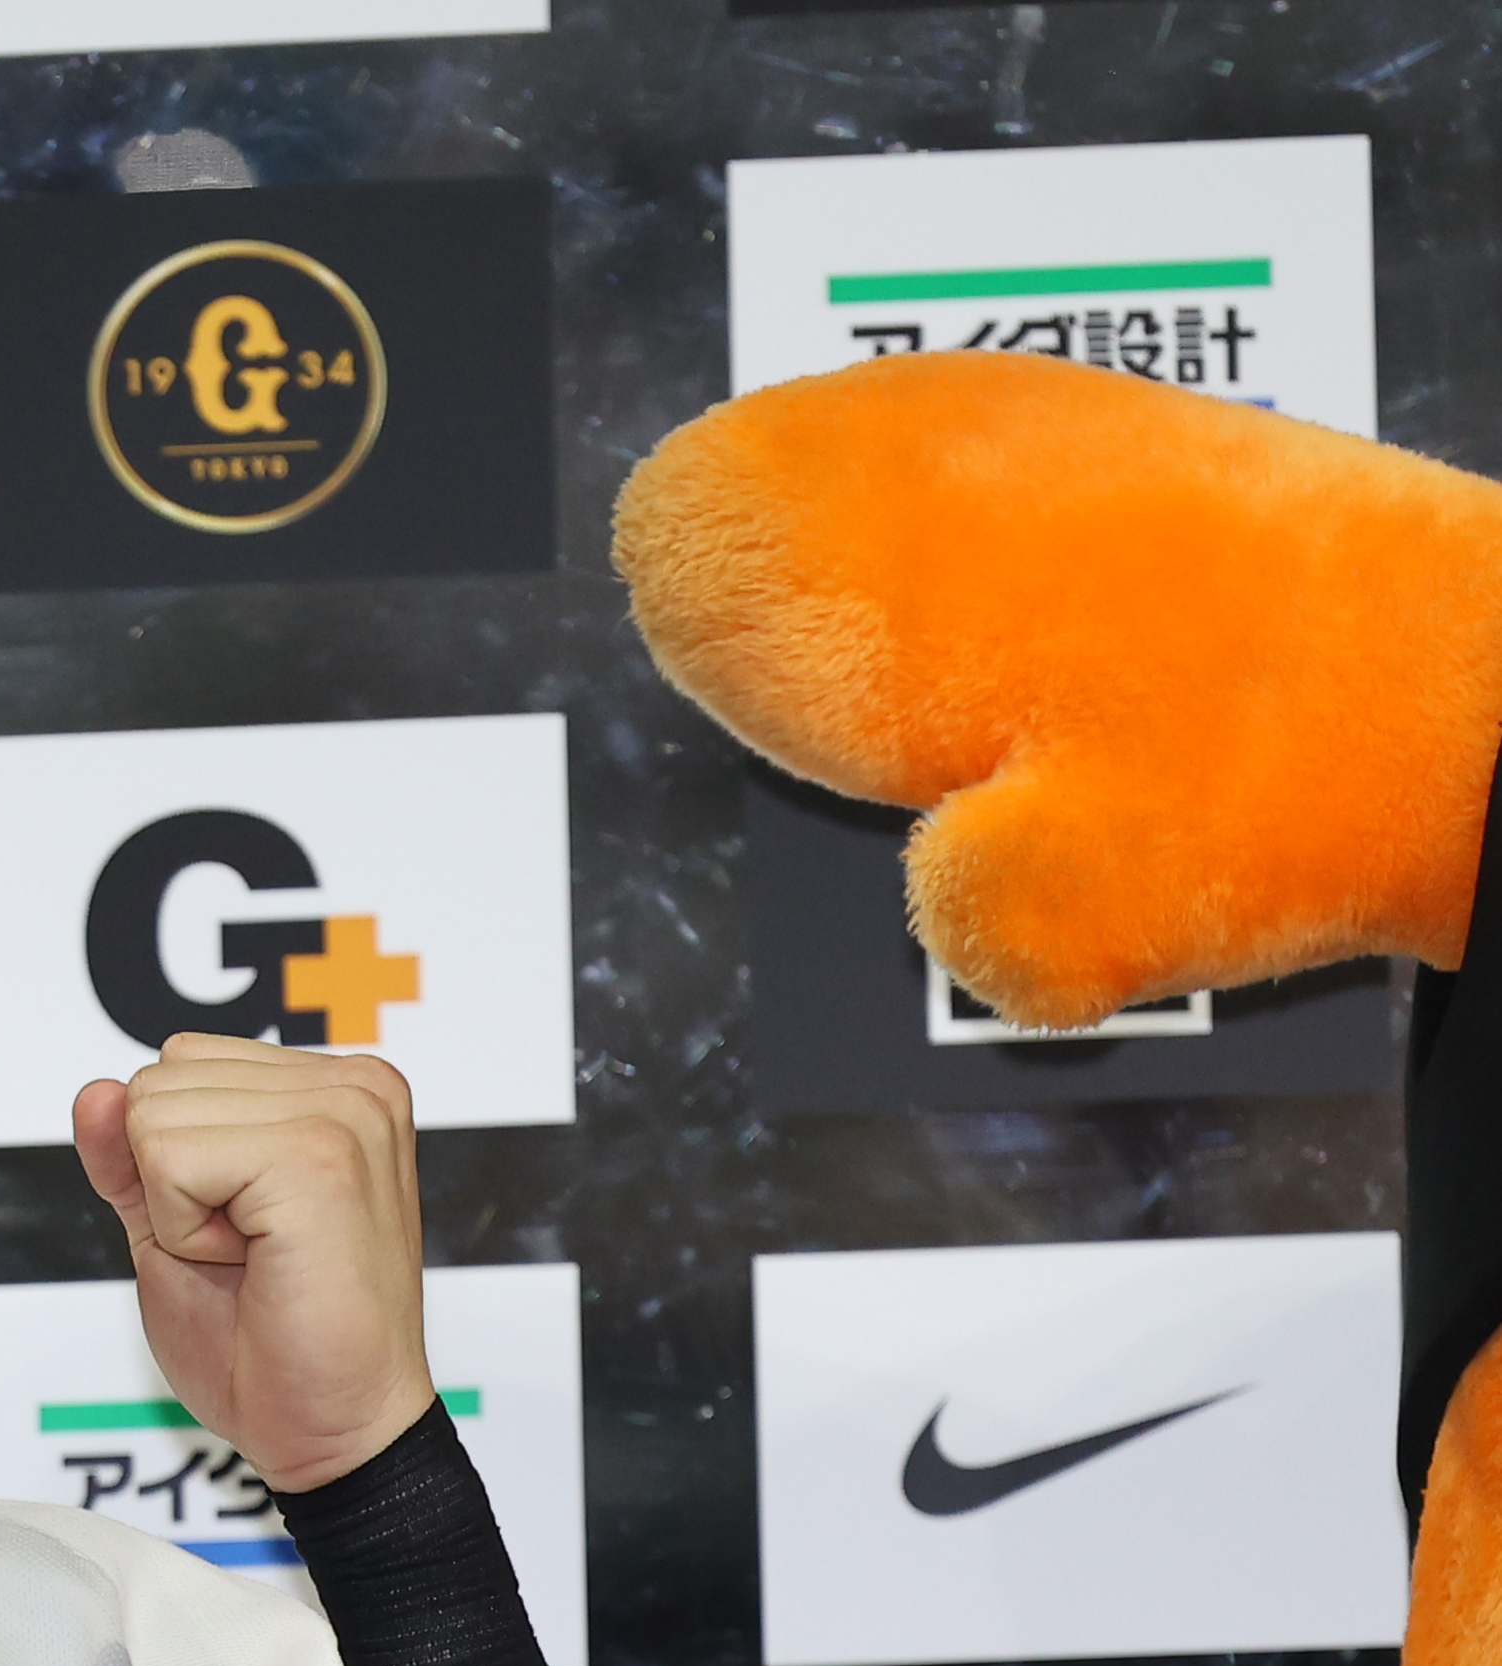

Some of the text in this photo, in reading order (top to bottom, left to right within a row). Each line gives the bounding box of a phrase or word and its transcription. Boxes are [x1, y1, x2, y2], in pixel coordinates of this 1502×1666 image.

[123, 295, 357, 434] 19 G 34
